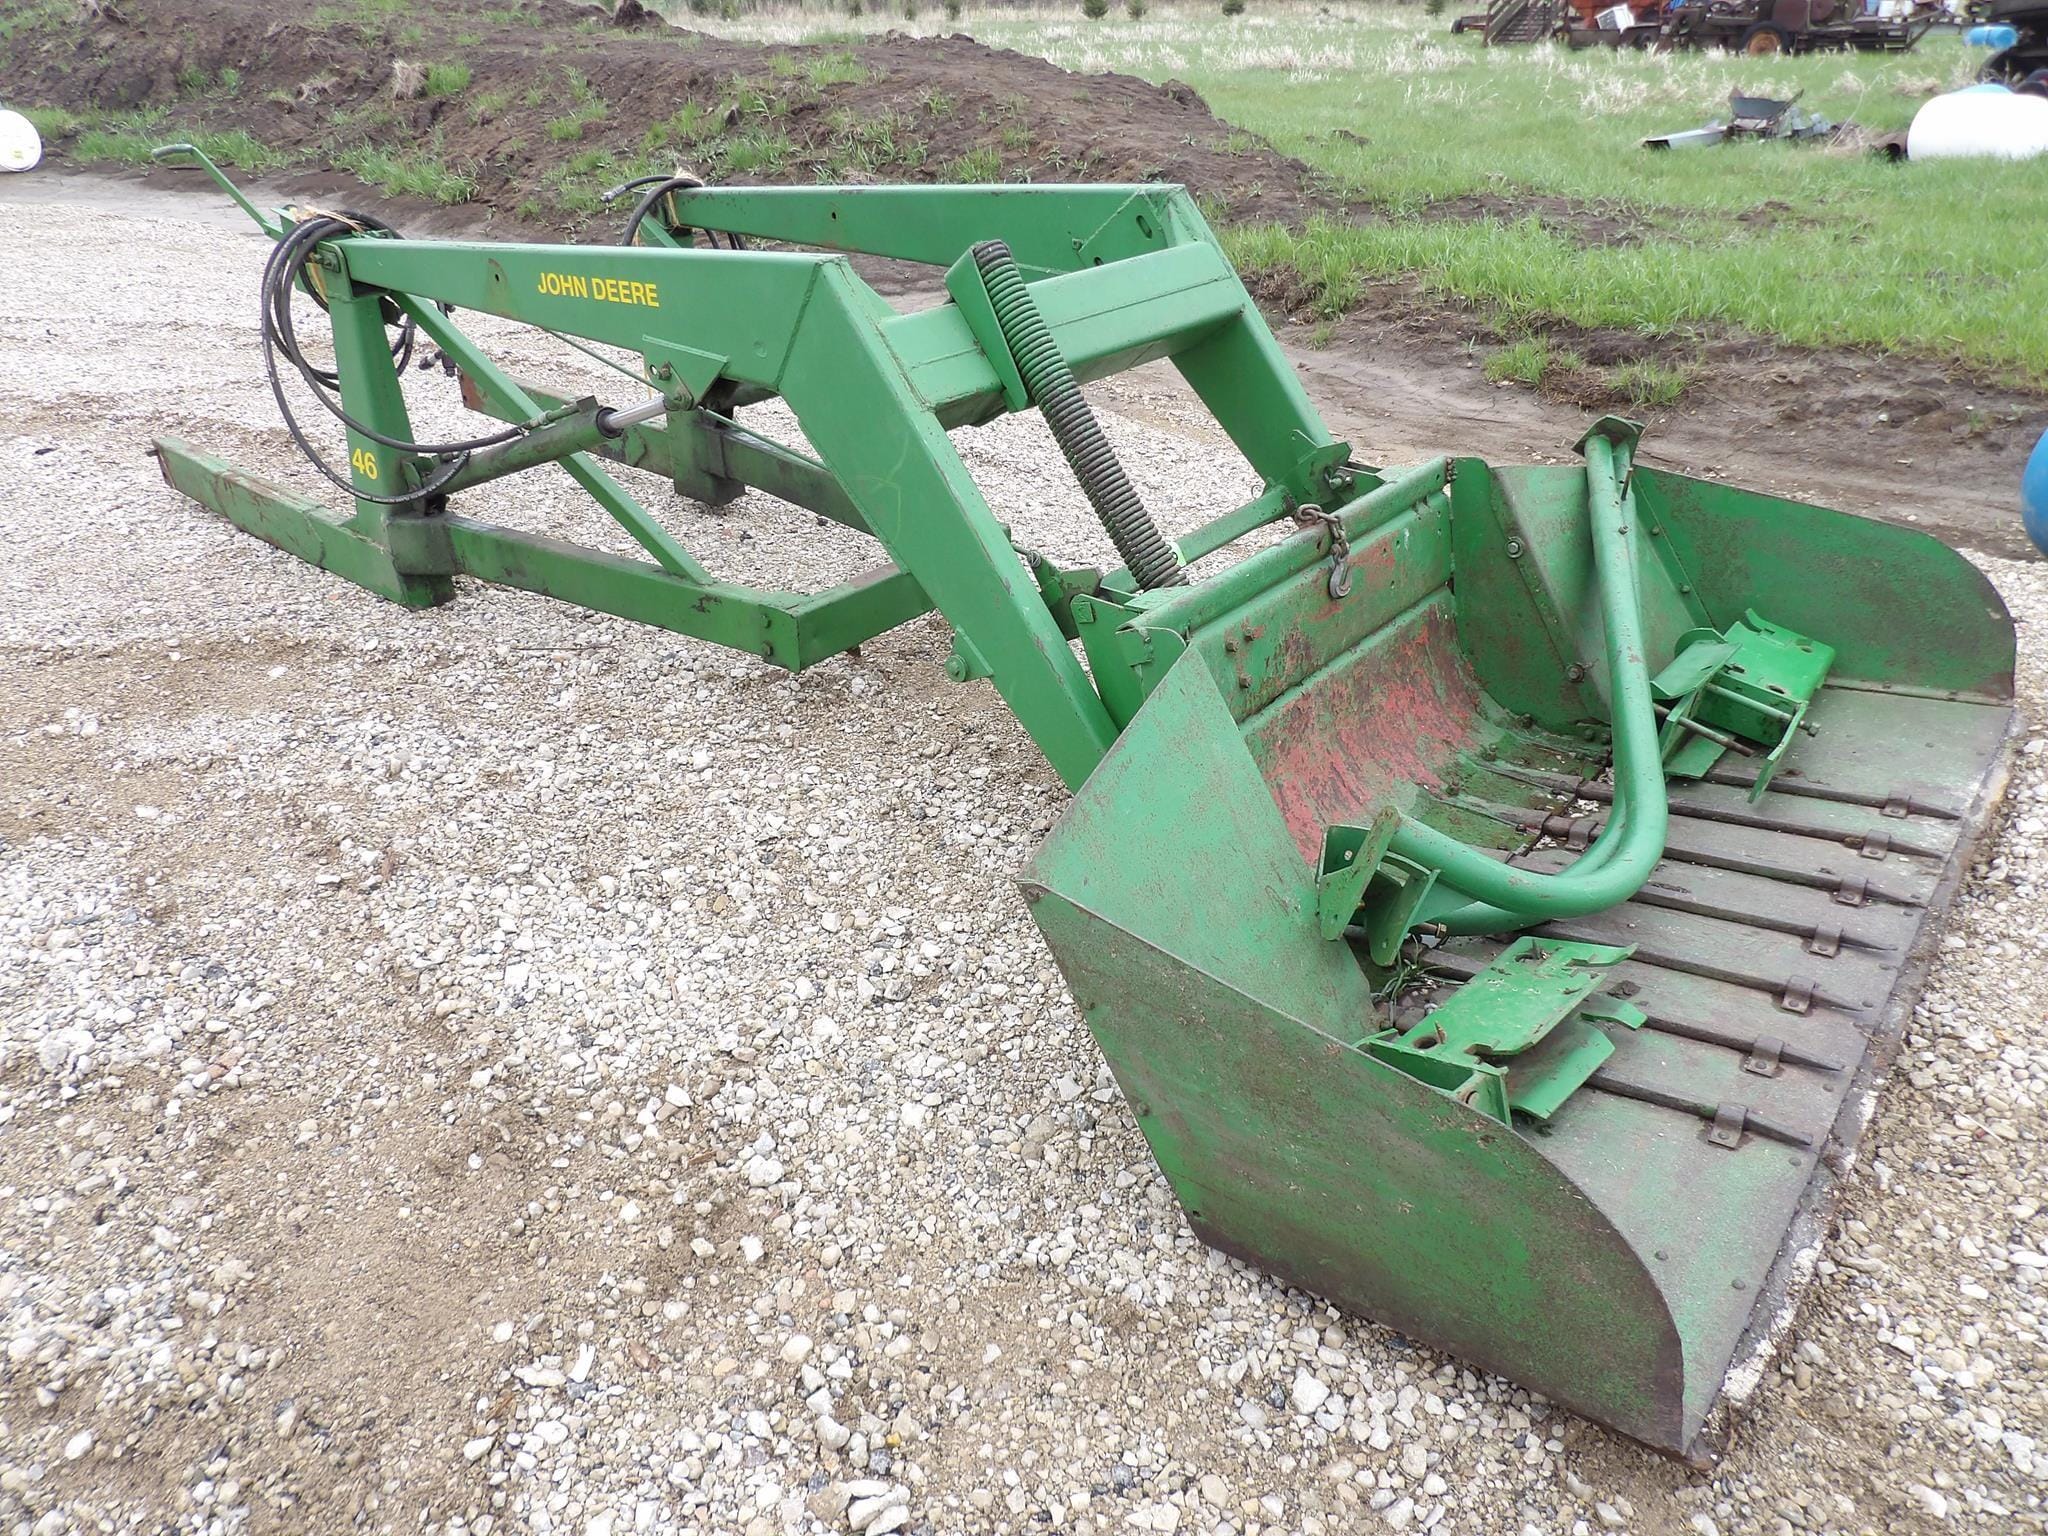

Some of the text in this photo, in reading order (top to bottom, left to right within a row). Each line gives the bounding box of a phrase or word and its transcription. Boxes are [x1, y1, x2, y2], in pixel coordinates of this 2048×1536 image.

[537, 272, 660, 307] JOHN DEERE
[352, 448, 378, 480] 46
